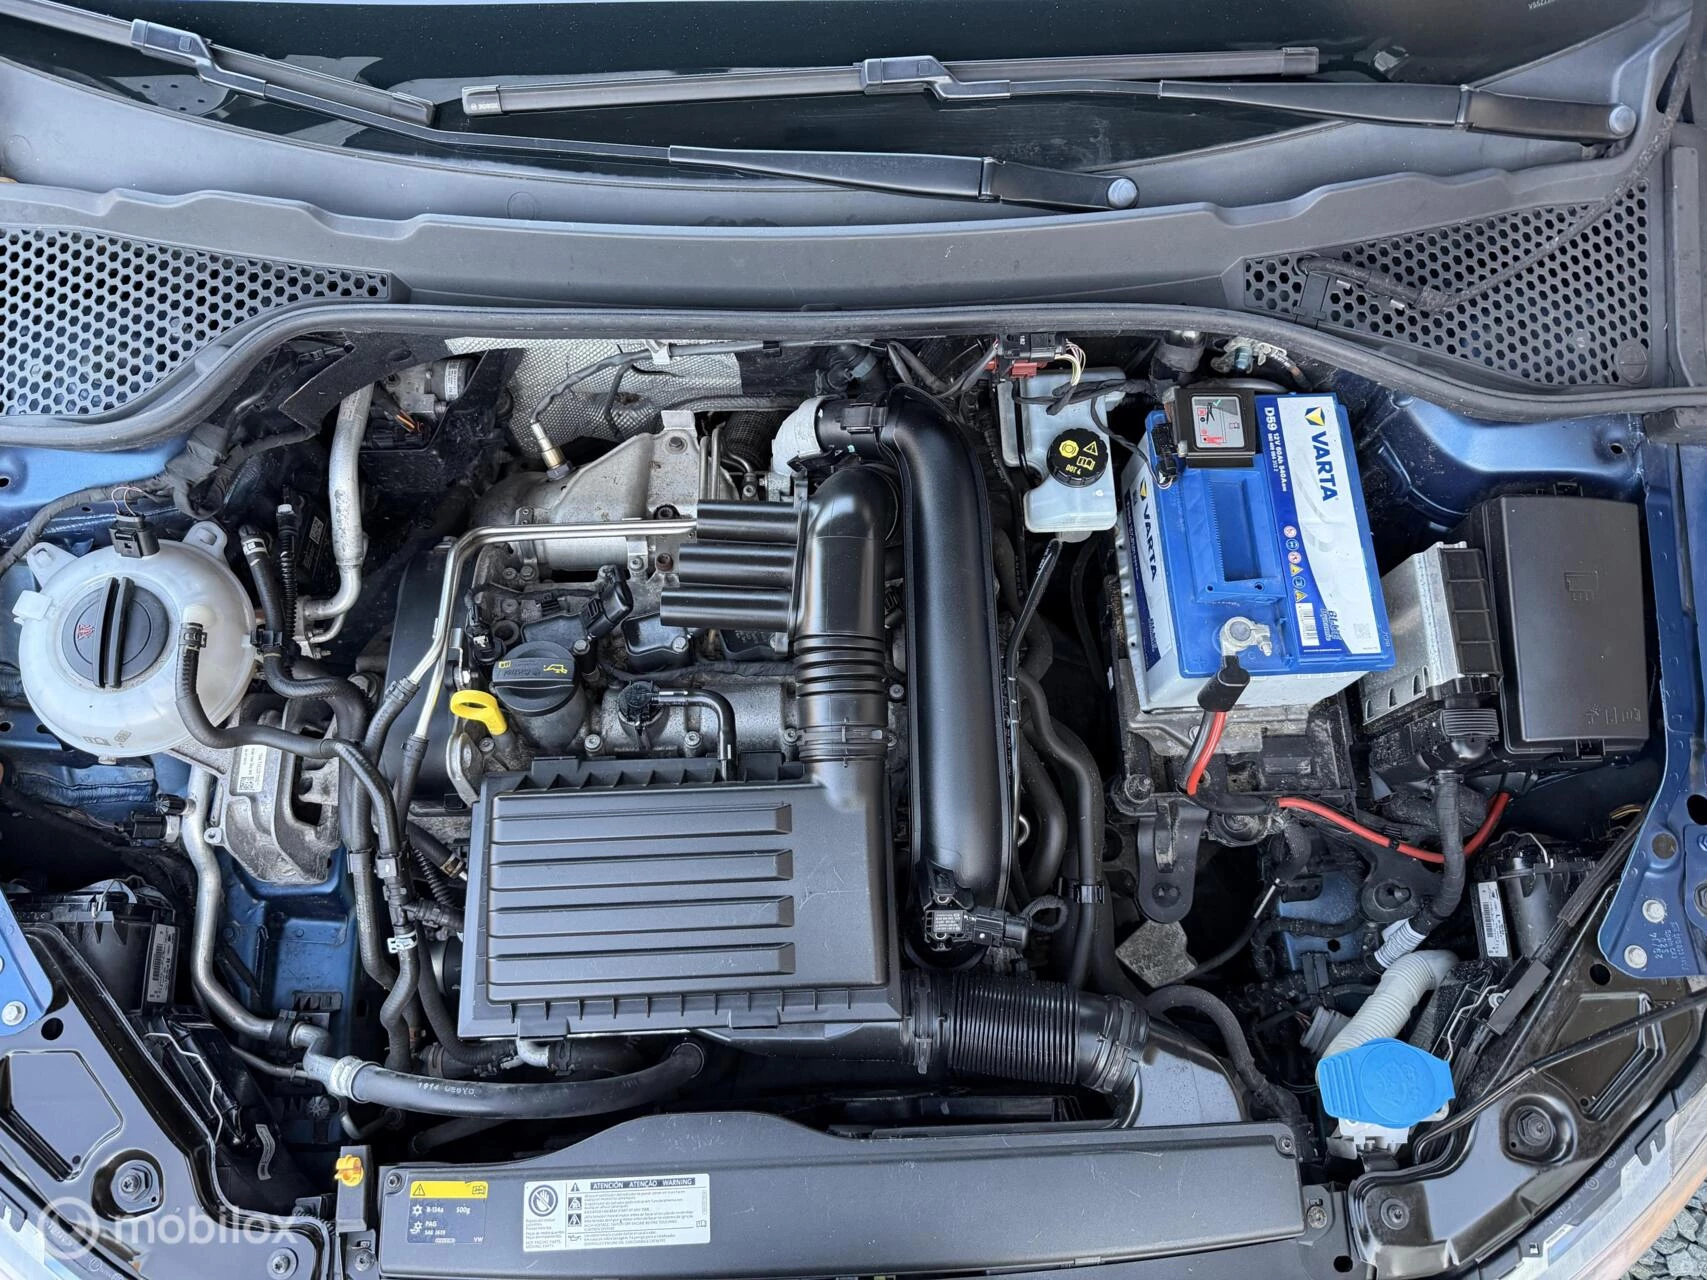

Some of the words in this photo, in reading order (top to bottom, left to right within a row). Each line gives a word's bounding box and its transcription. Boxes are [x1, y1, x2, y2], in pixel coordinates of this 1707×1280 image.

[1264, 407, 1278, 431] D59
[1273, 432, 1281, 446] 12V
[1065, 464, 1077, 473] DOT
[1312, 431, 1338, 501] VARTA
[1143, 502, 1157, 582] VARTA
[592, 1180, 624, 1190] ATENCIÓN
[628, 1179, 658, 1188] ATENÇÃO
[662, 1177, 693, 1186] WARNING
